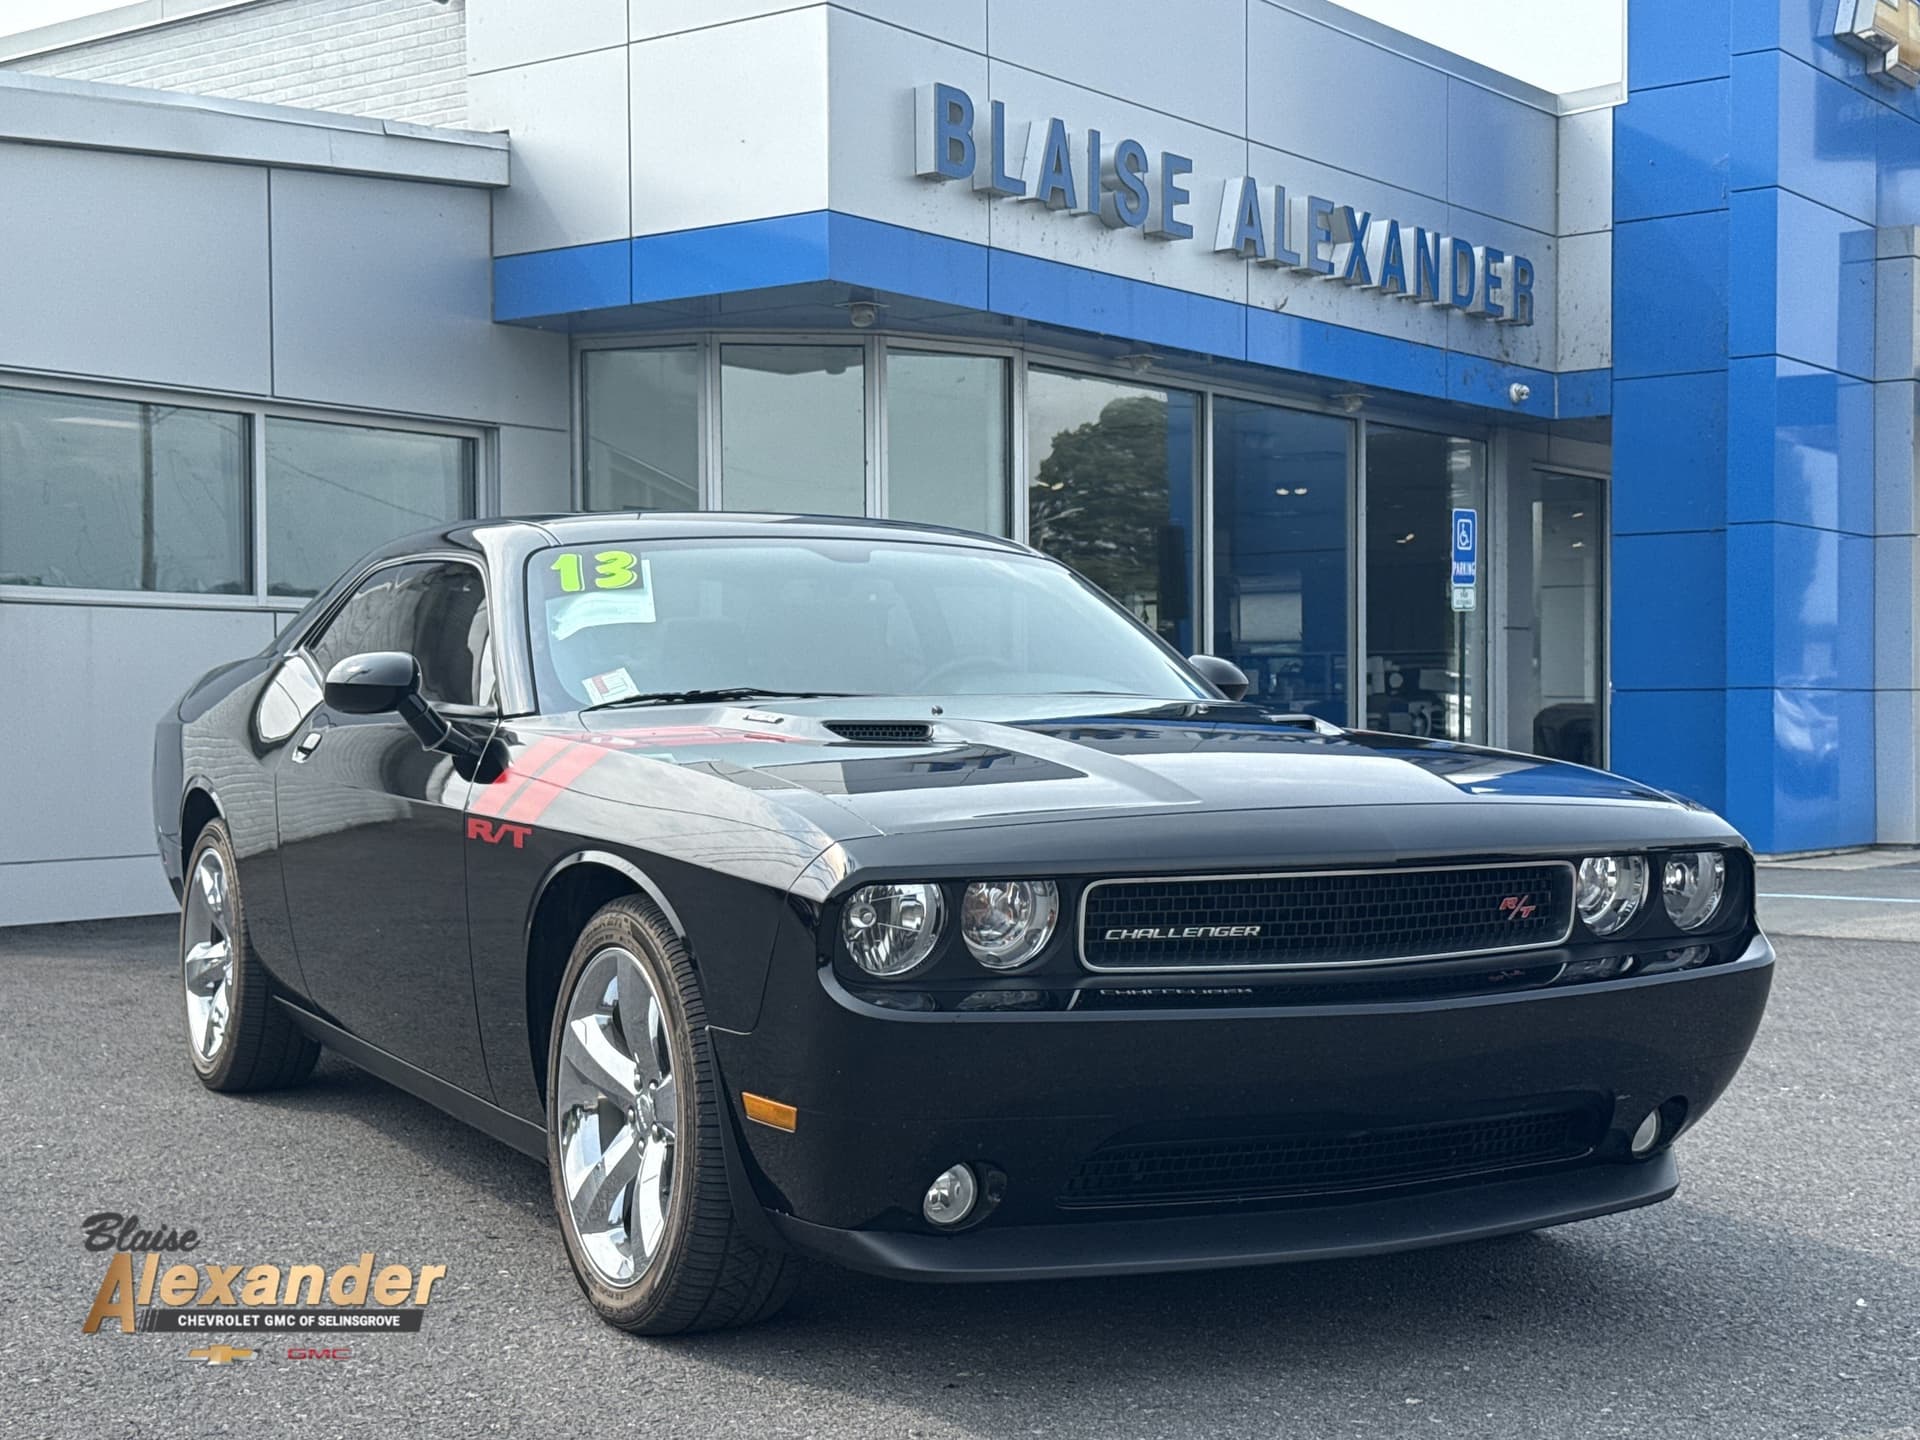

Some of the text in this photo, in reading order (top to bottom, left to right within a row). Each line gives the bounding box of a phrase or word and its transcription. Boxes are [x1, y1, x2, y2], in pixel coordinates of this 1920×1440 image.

[915, 82, 1535, 327] BLAISE ALEXANDER
[550, 550, 637, 592] 13
[467, 817, 533, 849] R/T
[1499, 894, 1536, 921] R/T
[1104, 925, 1261, 940] CHALLENGER
